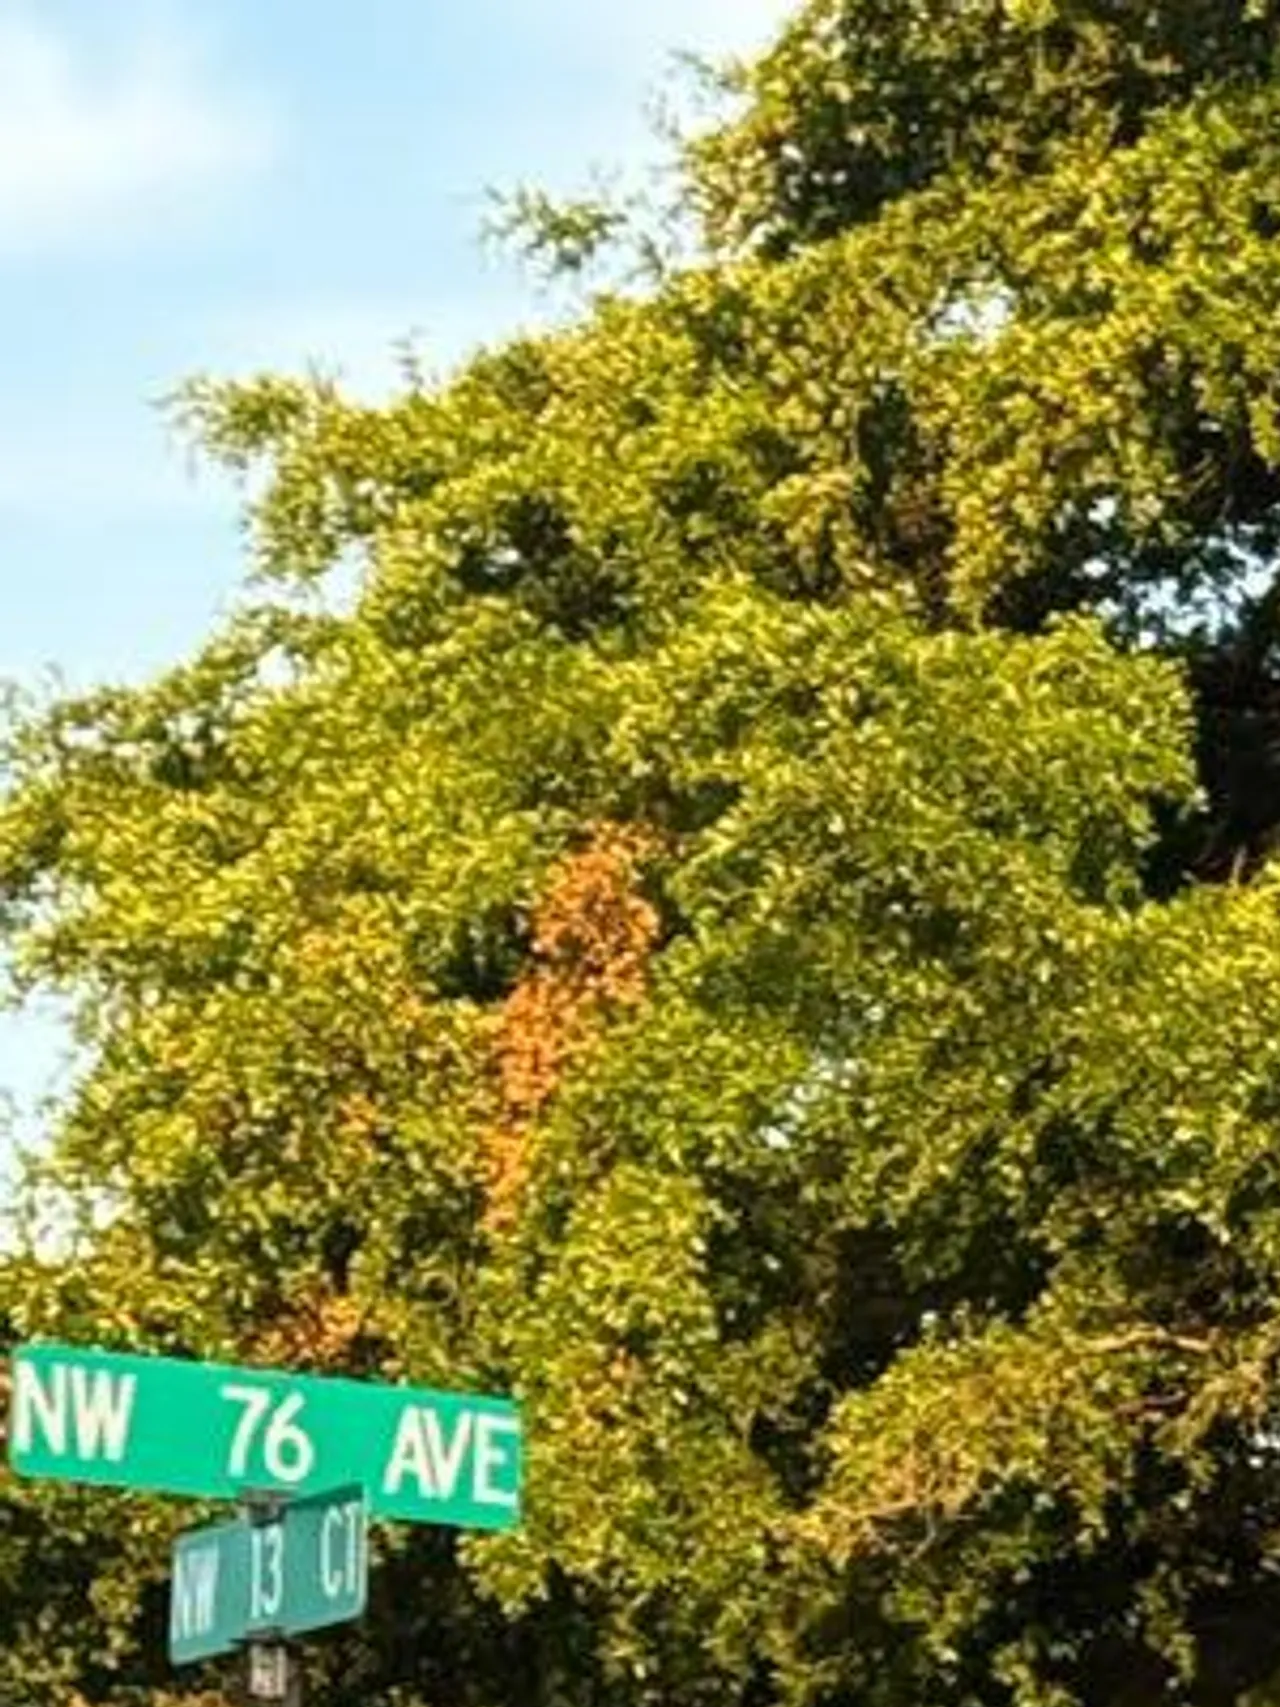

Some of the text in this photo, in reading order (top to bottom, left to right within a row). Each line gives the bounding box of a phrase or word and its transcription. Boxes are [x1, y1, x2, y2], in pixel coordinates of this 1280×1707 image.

[12, 1360, 519, 1506] NW 76 AVE
[172, 1502, 360, 1642] NW 13 CT
